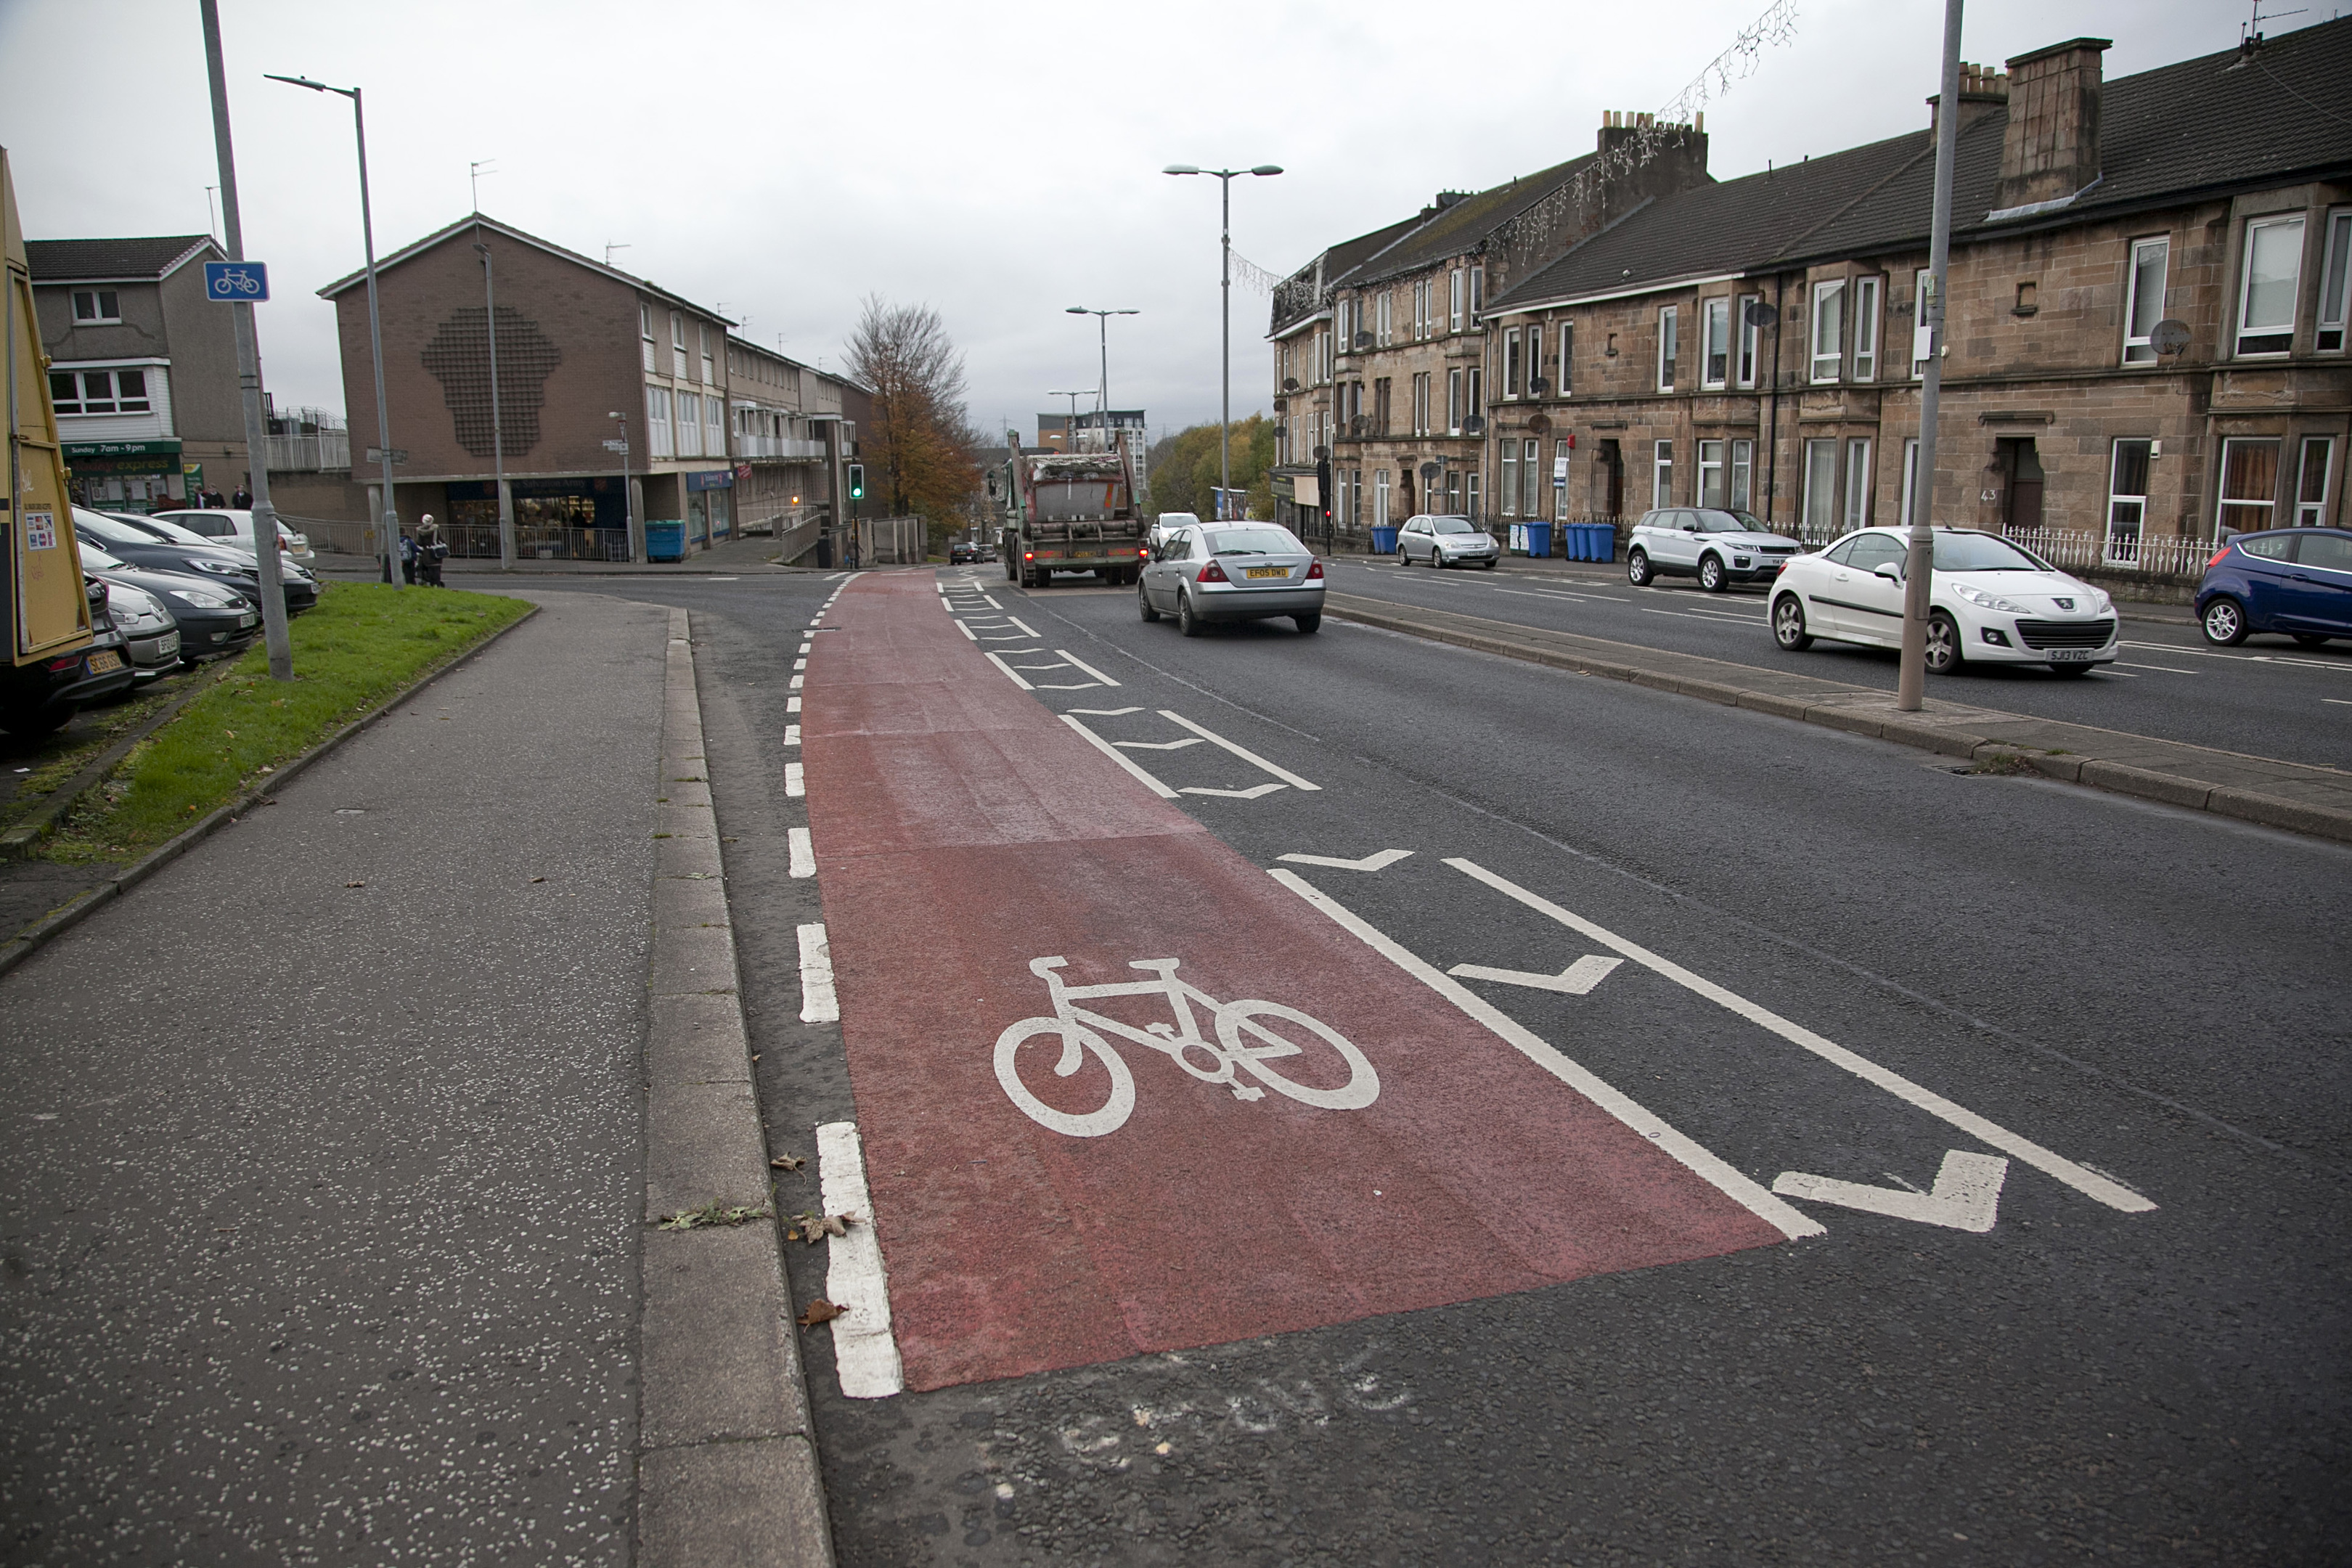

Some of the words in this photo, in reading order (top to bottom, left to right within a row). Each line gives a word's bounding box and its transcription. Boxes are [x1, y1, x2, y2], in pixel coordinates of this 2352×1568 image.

[100, 444, 119, 453] 7am
[126, 444, 145, 453] 9pm
[116, 460, 168, 471] express
[523, 478, 561, 489] Salvation
[563, 477, 586, 489] Army
[1980, 489, 1996, 502] 43
[1249, 568, 1270, 577] EF05
[1271, 568, 1286, 576] DWD
[2051, 650, 2071, 661] SJ13
[2073, 650, 2089, 660] VZC
